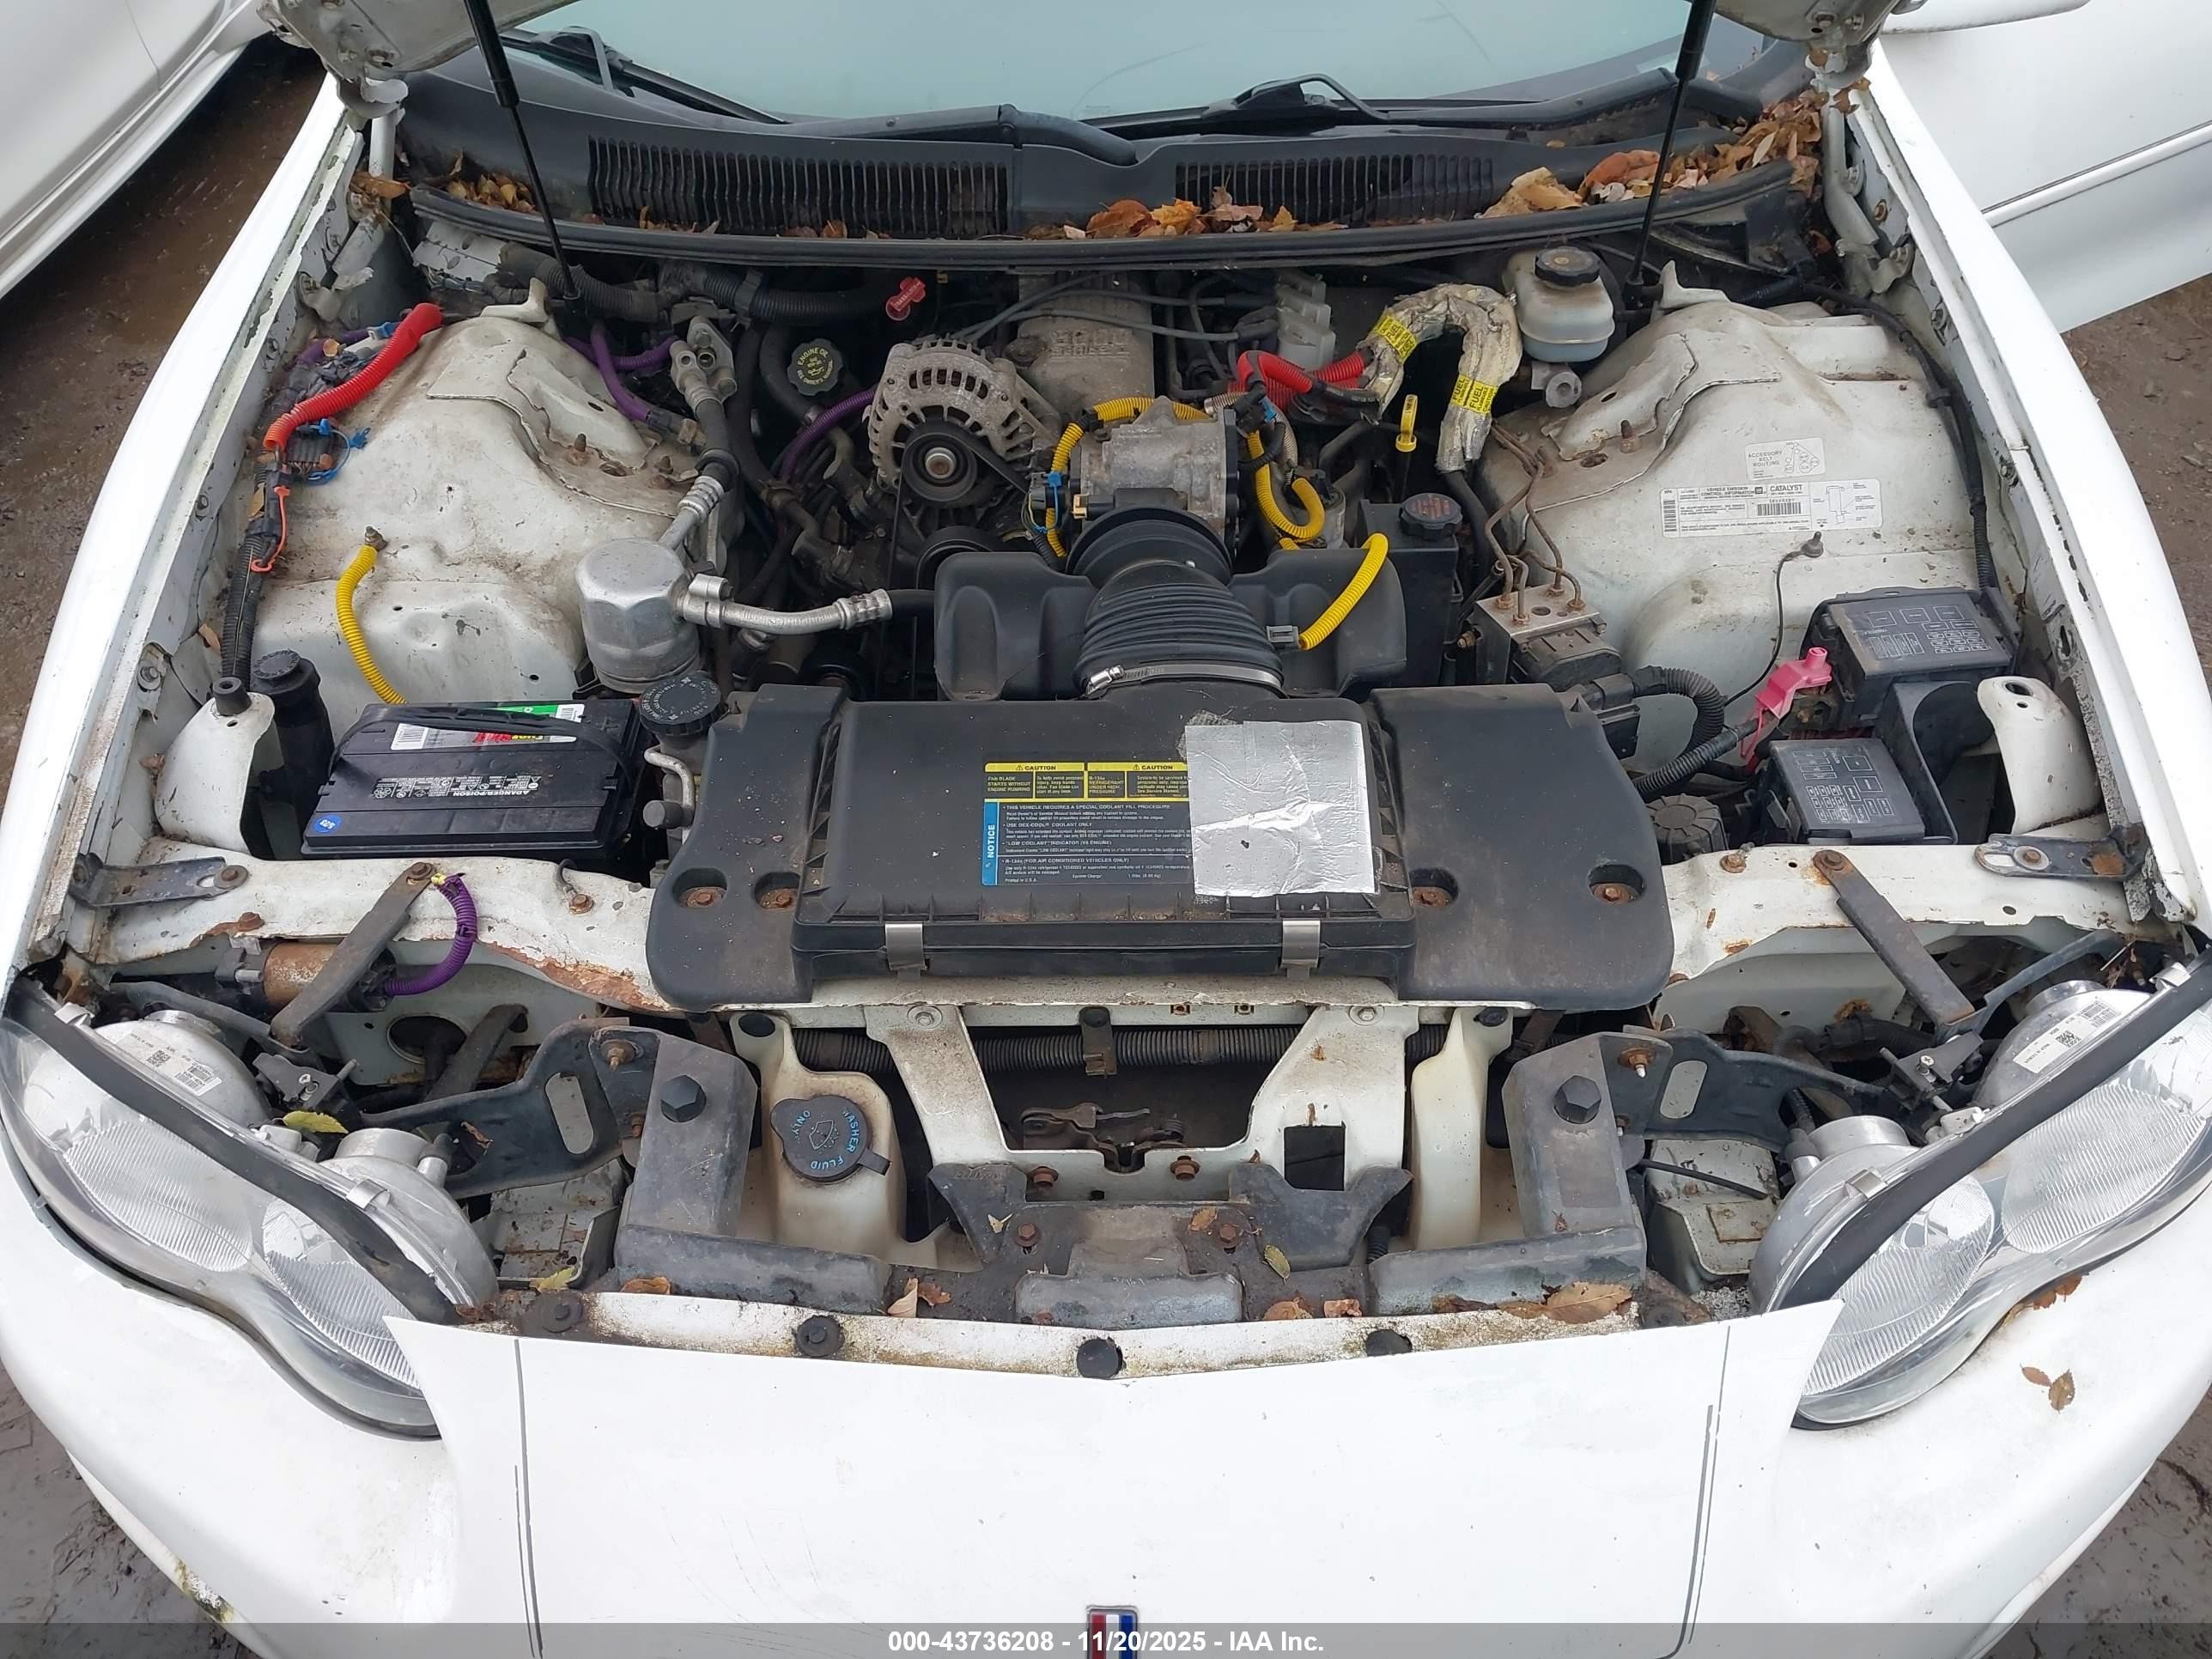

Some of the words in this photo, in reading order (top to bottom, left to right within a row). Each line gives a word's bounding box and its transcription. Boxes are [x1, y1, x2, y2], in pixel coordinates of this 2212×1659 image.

[797, 347, 820, 366] ENGINE
[1453, 379, 1465, 400] FUEL
[1469, 386, 1484, 408] FUEL
[792, 1109, 811, 1136] ONLY
[811, 1154, 845, 1170] FLUID
